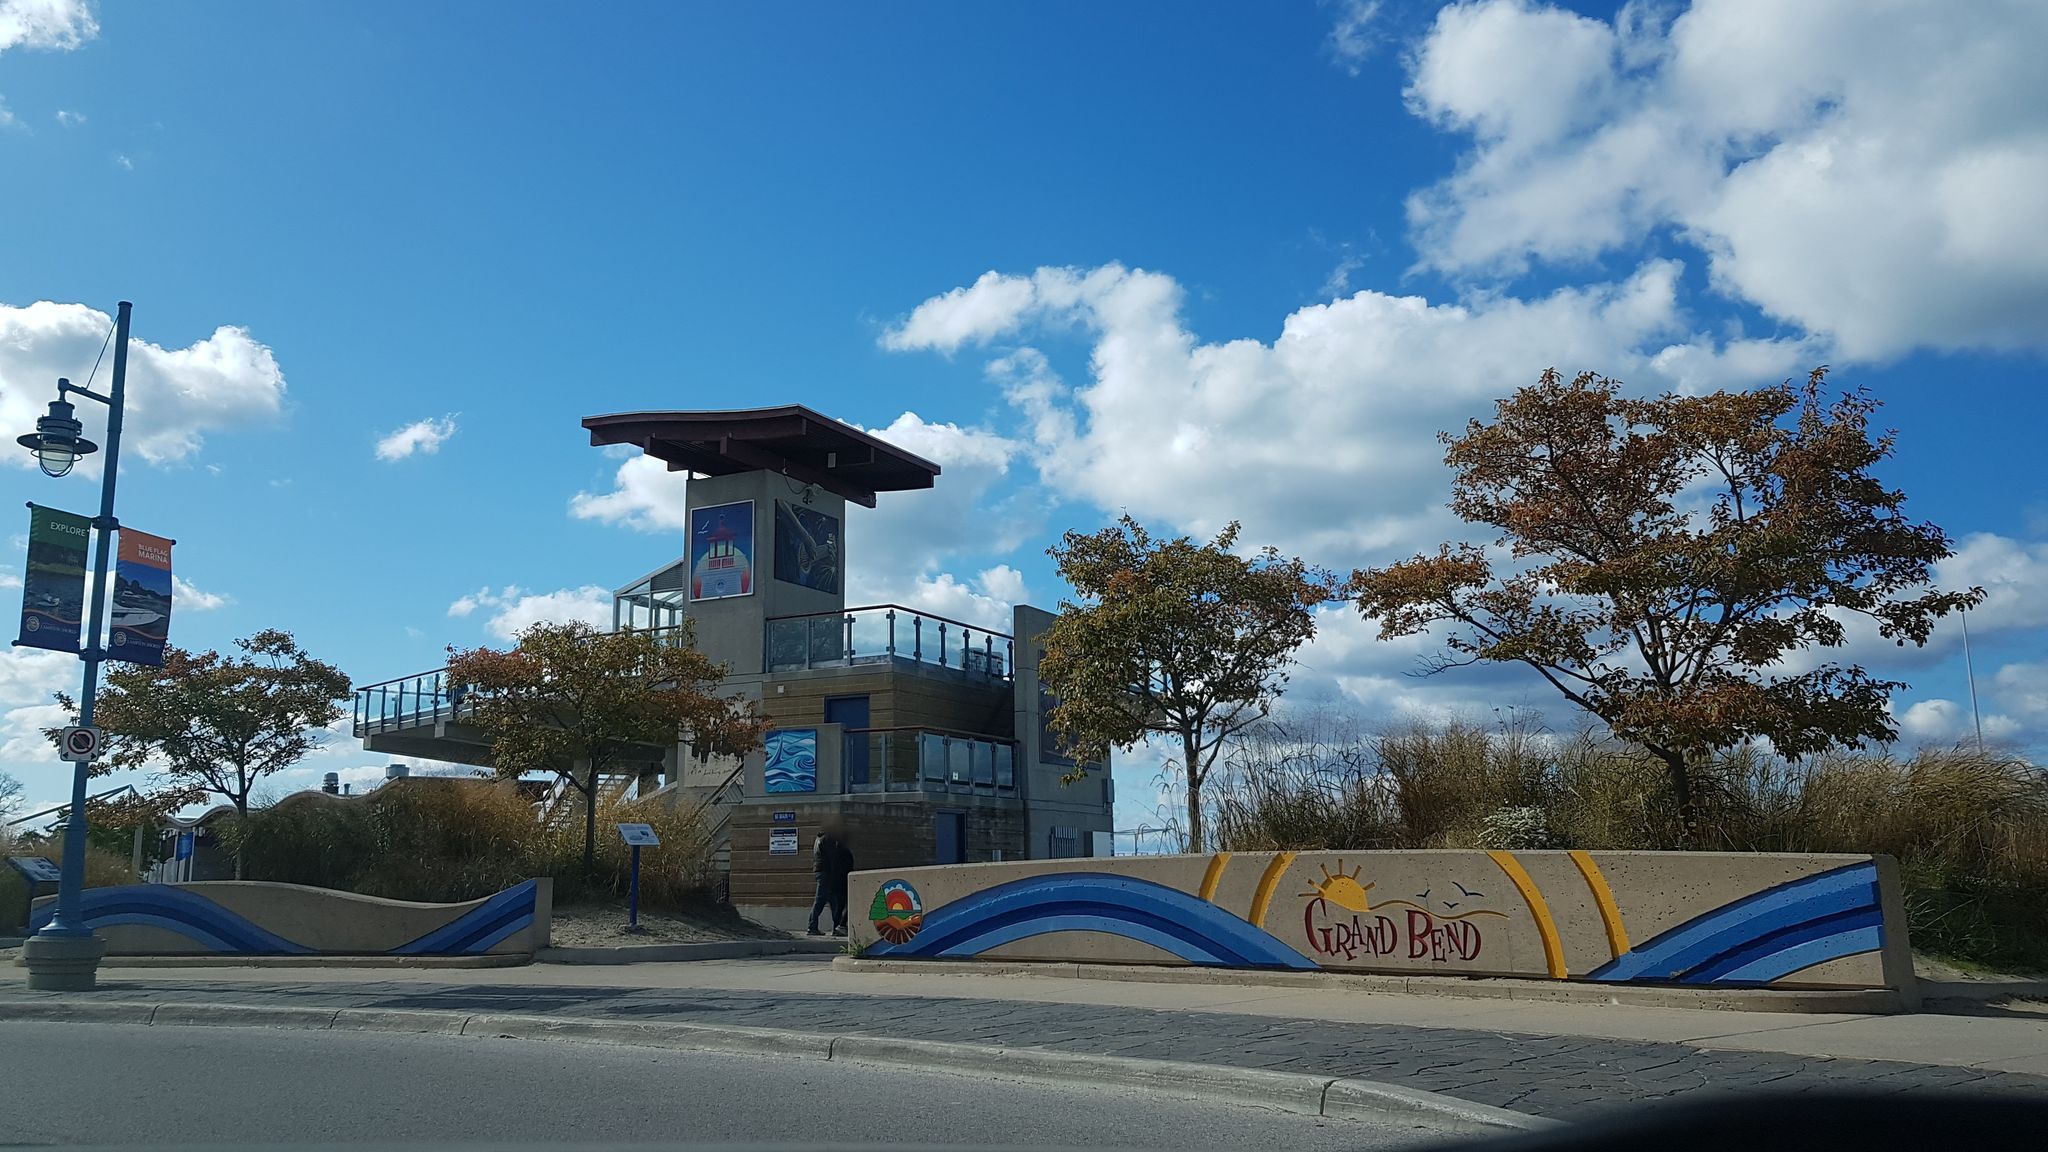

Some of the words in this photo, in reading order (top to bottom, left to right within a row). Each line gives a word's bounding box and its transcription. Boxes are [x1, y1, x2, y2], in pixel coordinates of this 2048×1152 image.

[50, 521, 86, 537] EXPLORE
[138, 543, 153, 553] BLUE
[153, 547, 168, 557] FLAG
[138, 550, 169, 564] MARINA
[1304, 897, 1398, 962] GRAND
[1405, 909, 1482, 962] BEND
